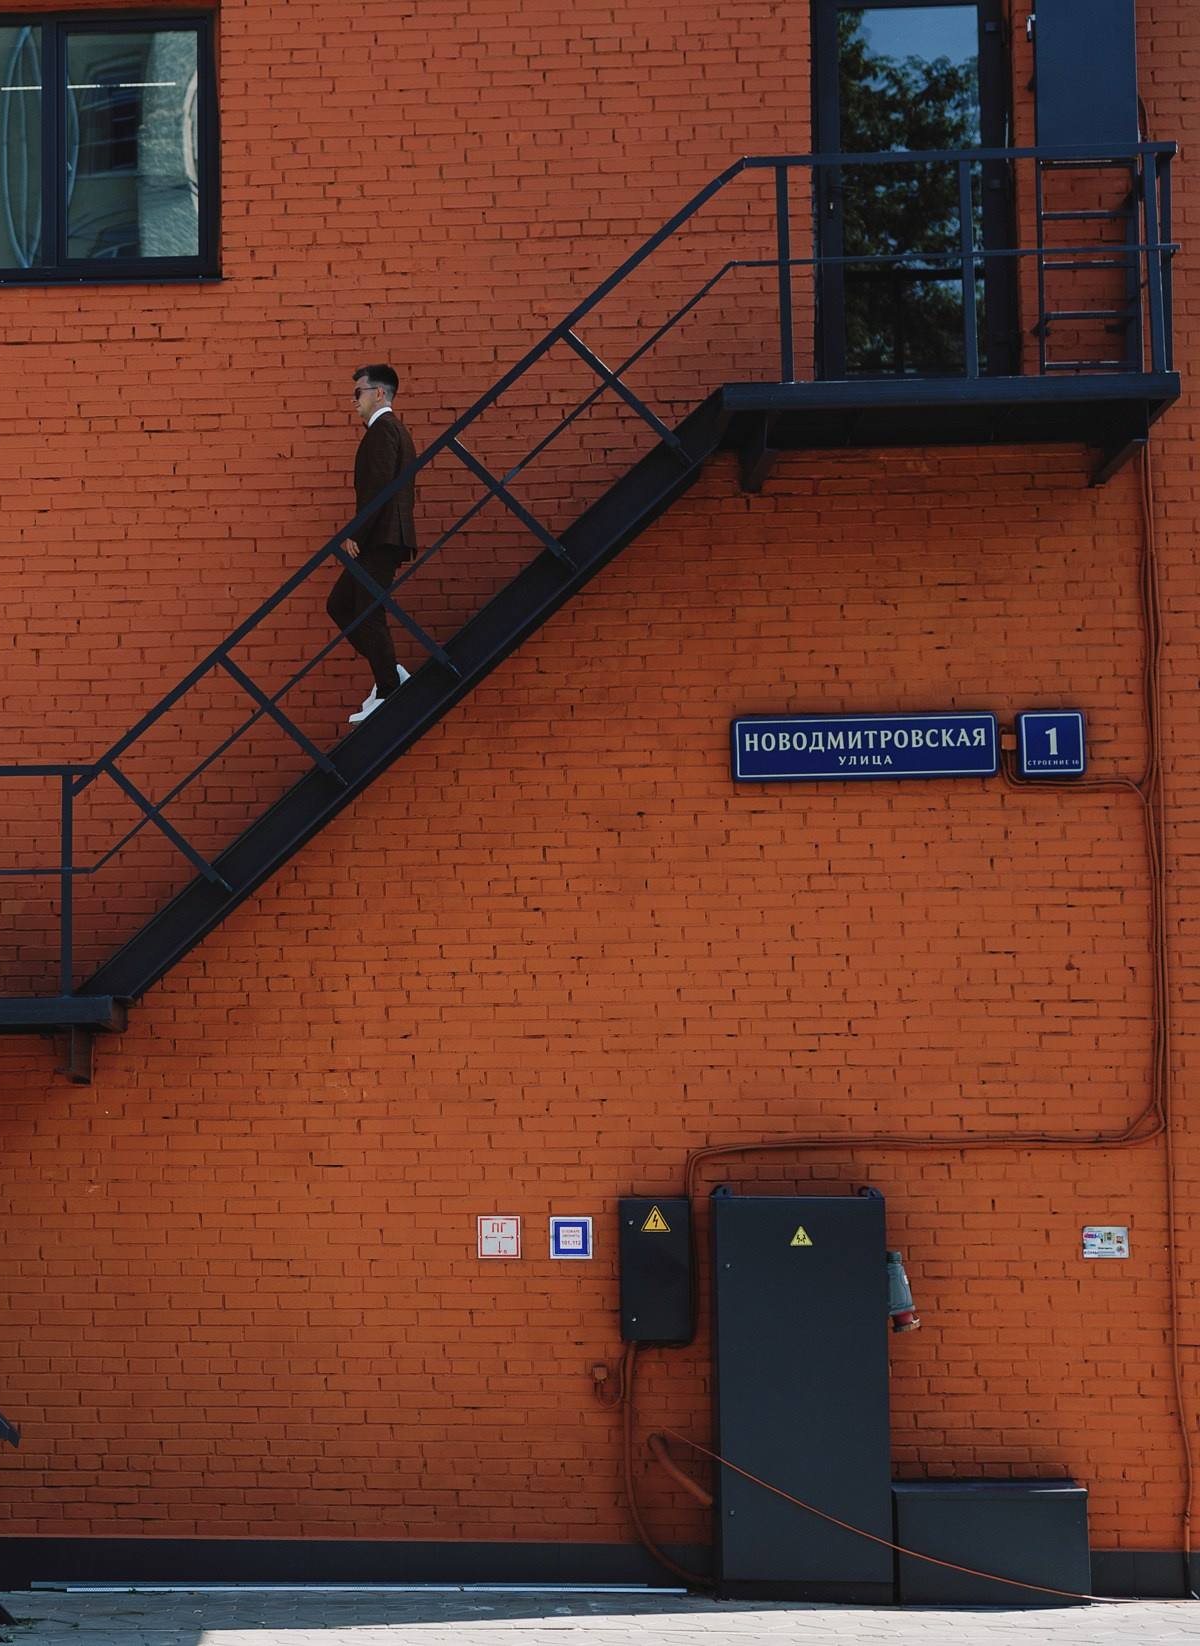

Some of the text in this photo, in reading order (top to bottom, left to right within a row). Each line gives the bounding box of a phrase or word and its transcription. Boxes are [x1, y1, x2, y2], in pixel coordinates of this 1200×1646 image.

[744, 727, 987, 753] НОВОДМИТРОВСКАЯ
[1045, 727, 1058, 755] 1
[838, 755, 893, 765] УЛИЦА
[492, 1222, 506, 1232] ПГ
